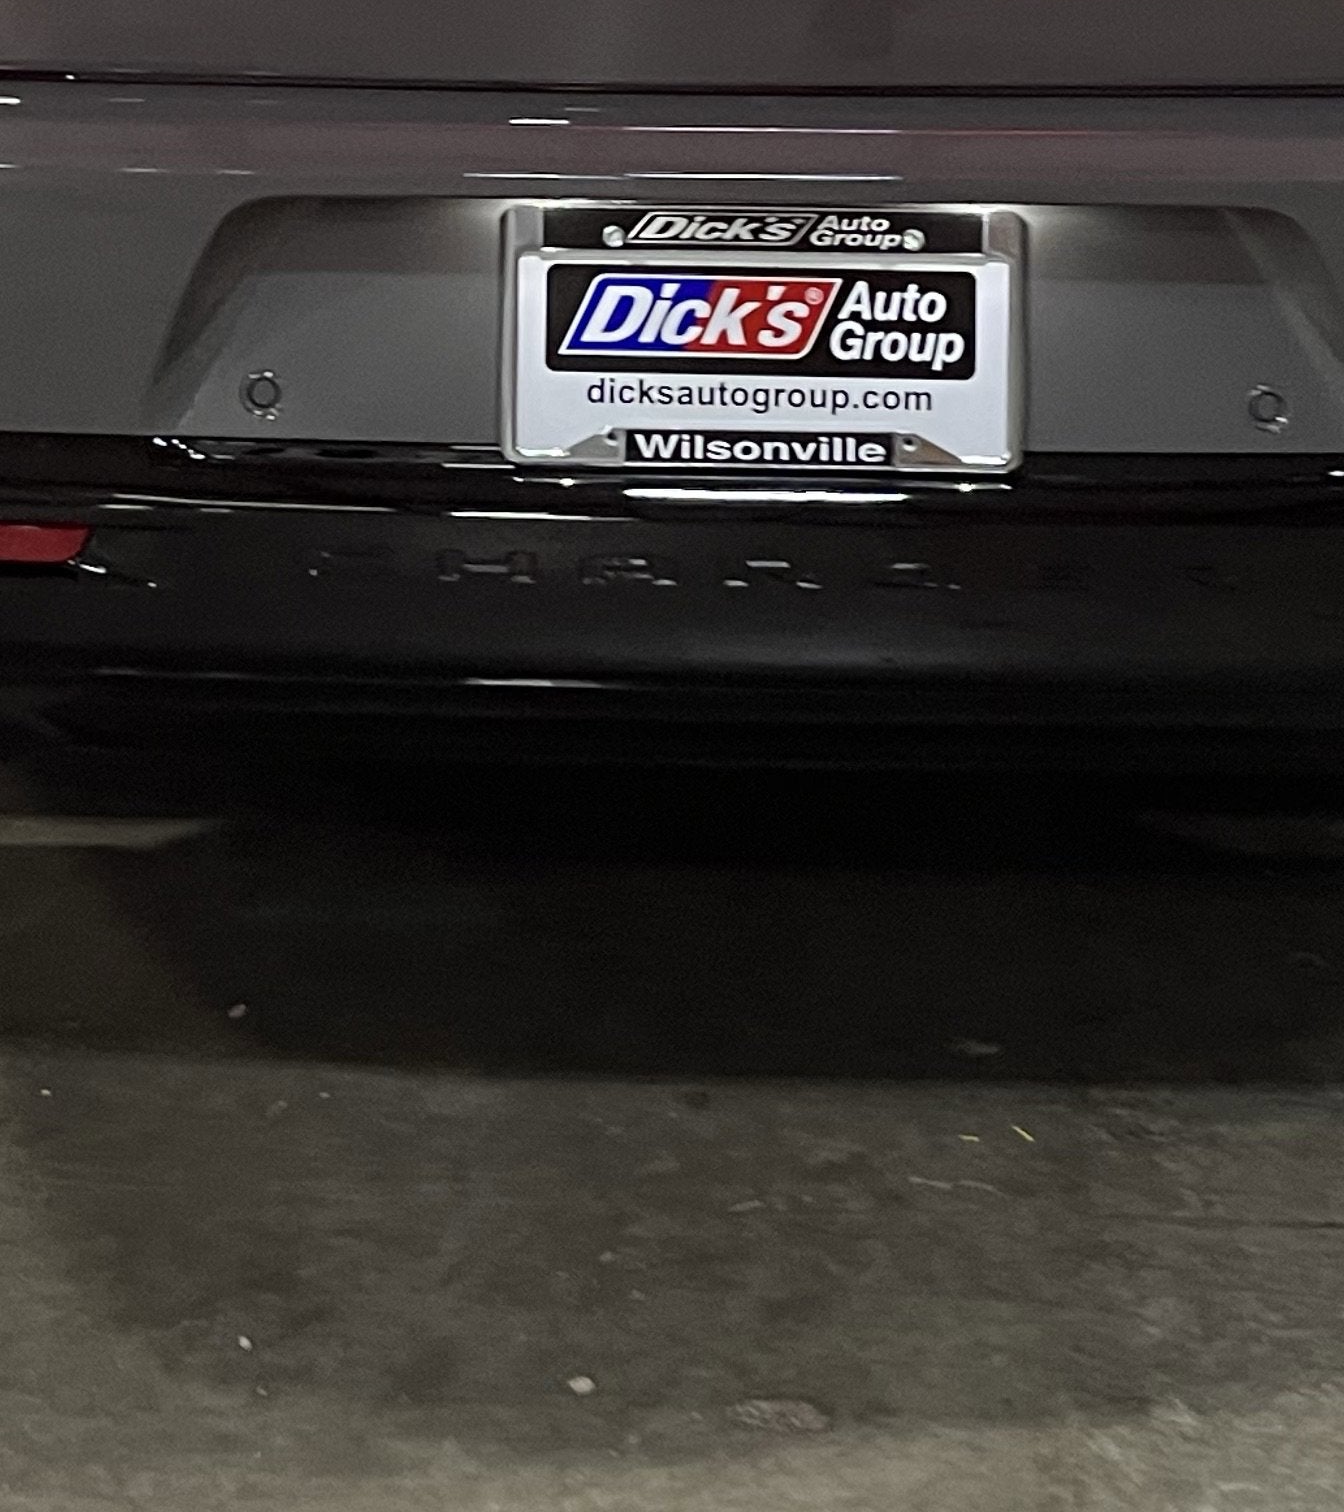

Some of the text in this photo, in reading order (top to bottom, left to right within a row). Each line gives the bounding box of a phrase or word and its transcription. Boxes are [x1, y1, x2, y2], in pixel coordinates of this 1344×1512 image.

[639, 215, 797, 241] Dick's
[809, 229, 903, 251] Group
[817, 215, 891, 231] Auto
[580, 282, 812, 348] Dick's
[838, 280, 948, 324] Auto
[829, 326, 965, 372] Group
[587, 379, 933, 416] dicksautogroup.com
[632, 433, 887, 464] Wilsonville
